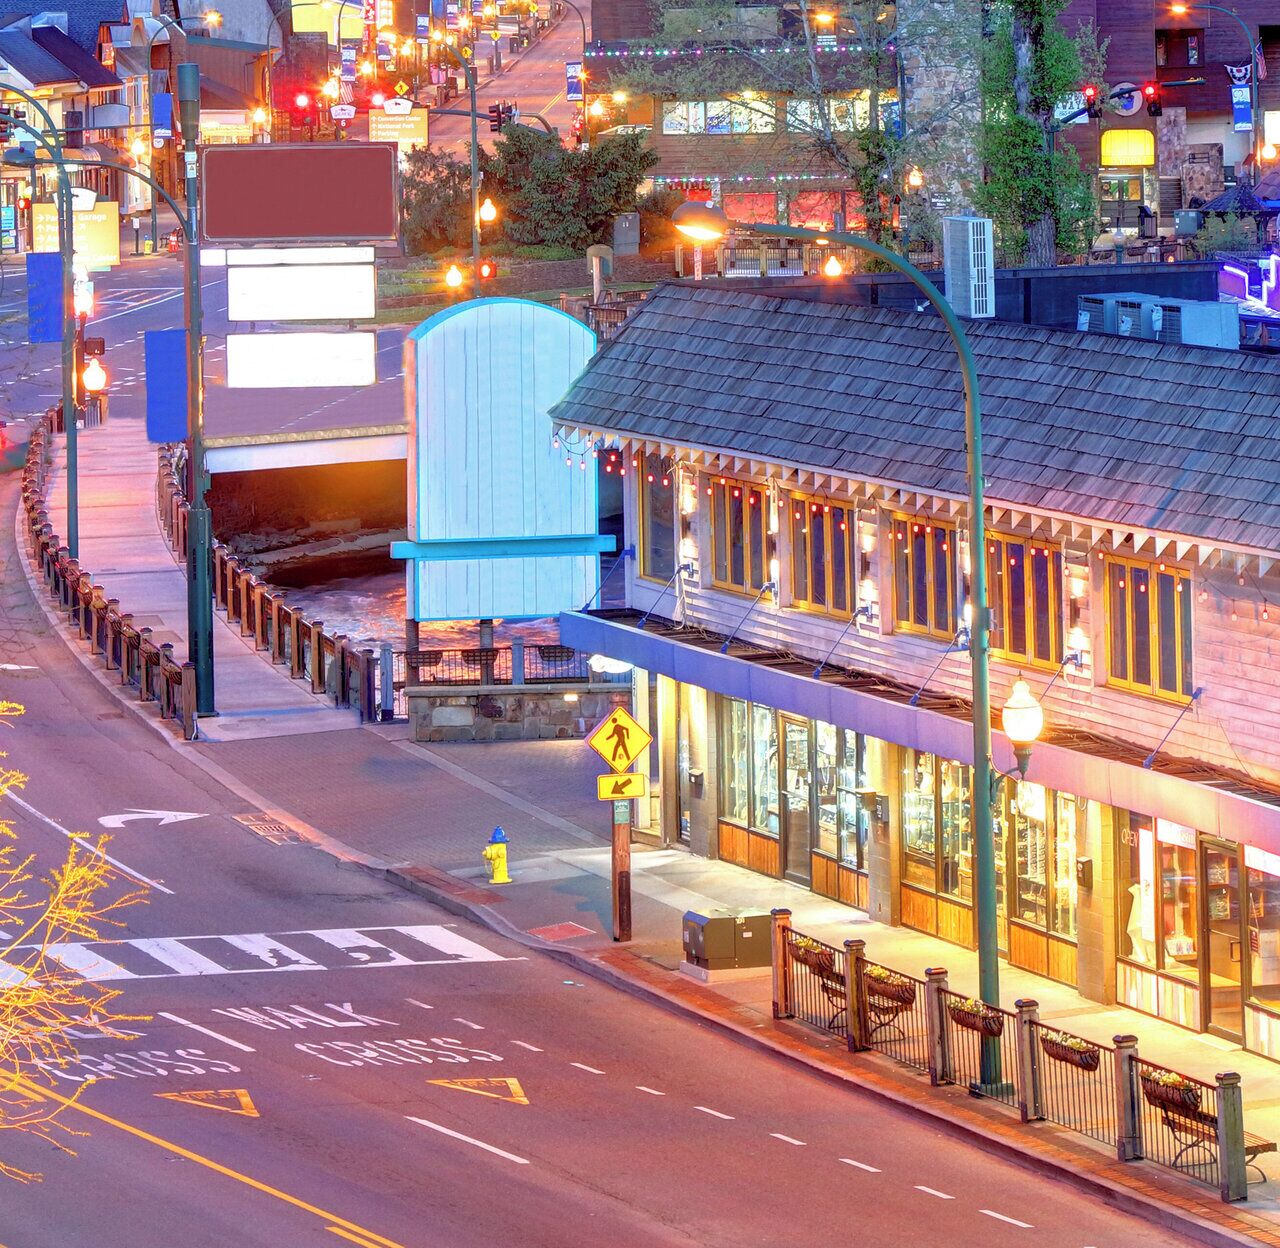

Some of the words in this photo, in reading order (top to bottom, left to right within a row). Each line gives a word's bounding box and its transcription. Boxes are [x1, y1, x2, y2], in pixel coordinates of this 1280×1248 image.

[340, 119, 347, 127] 6
[78, 214, 107, 222] Garage
[1121, 828, 1139, 848] OPEN
[211, 1002, 400, 1030] WALK
[293, 1037, 504, 1067] CROSS
[32, 1048, 241, 1082] CROSS
